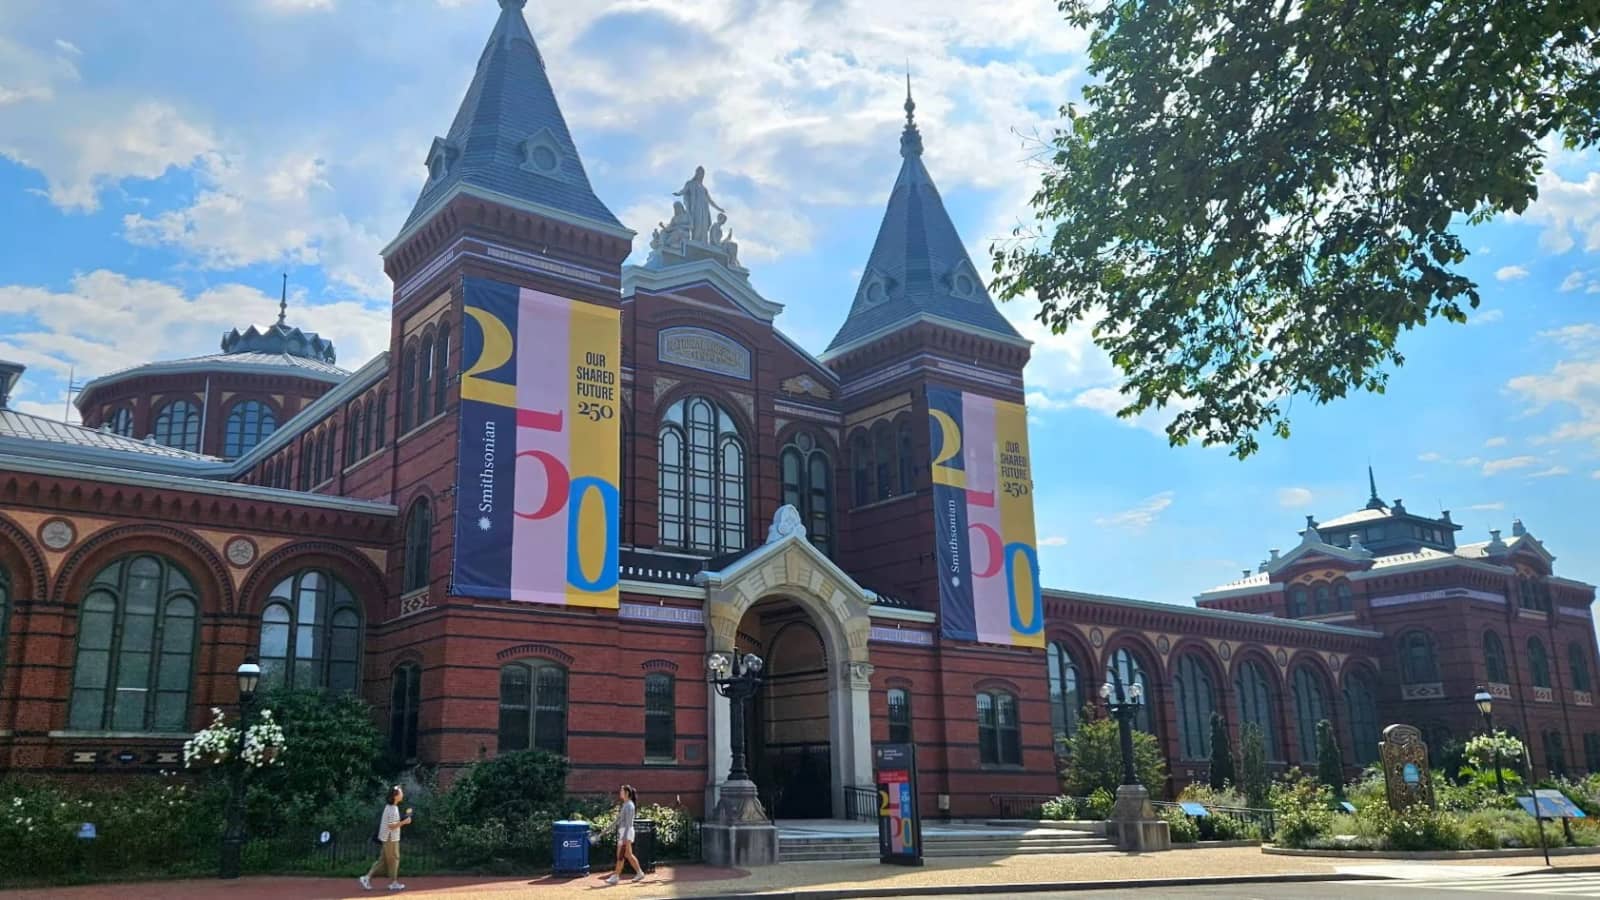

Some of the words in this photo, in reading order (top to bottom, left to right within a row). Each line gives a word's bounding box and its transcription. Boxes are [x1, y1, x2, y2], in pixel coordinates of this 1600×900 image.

[585, 351, 606, 368] OUR
[576, 366, 615, 386] SHARED
[576, 383, 615, 401] FUTURE
[578, 402, 614, 422] 250
[1005, 440, 1020, 454] OUR
[478, 420, 496, 513] Smithsonian
[1000, 453, 1027, 467] SHARED
[1001, 466, 1027, 481] FUTURE
[1003, 481, 1029, 498] 250
[948, 499, 960, 574] Smithsonian
